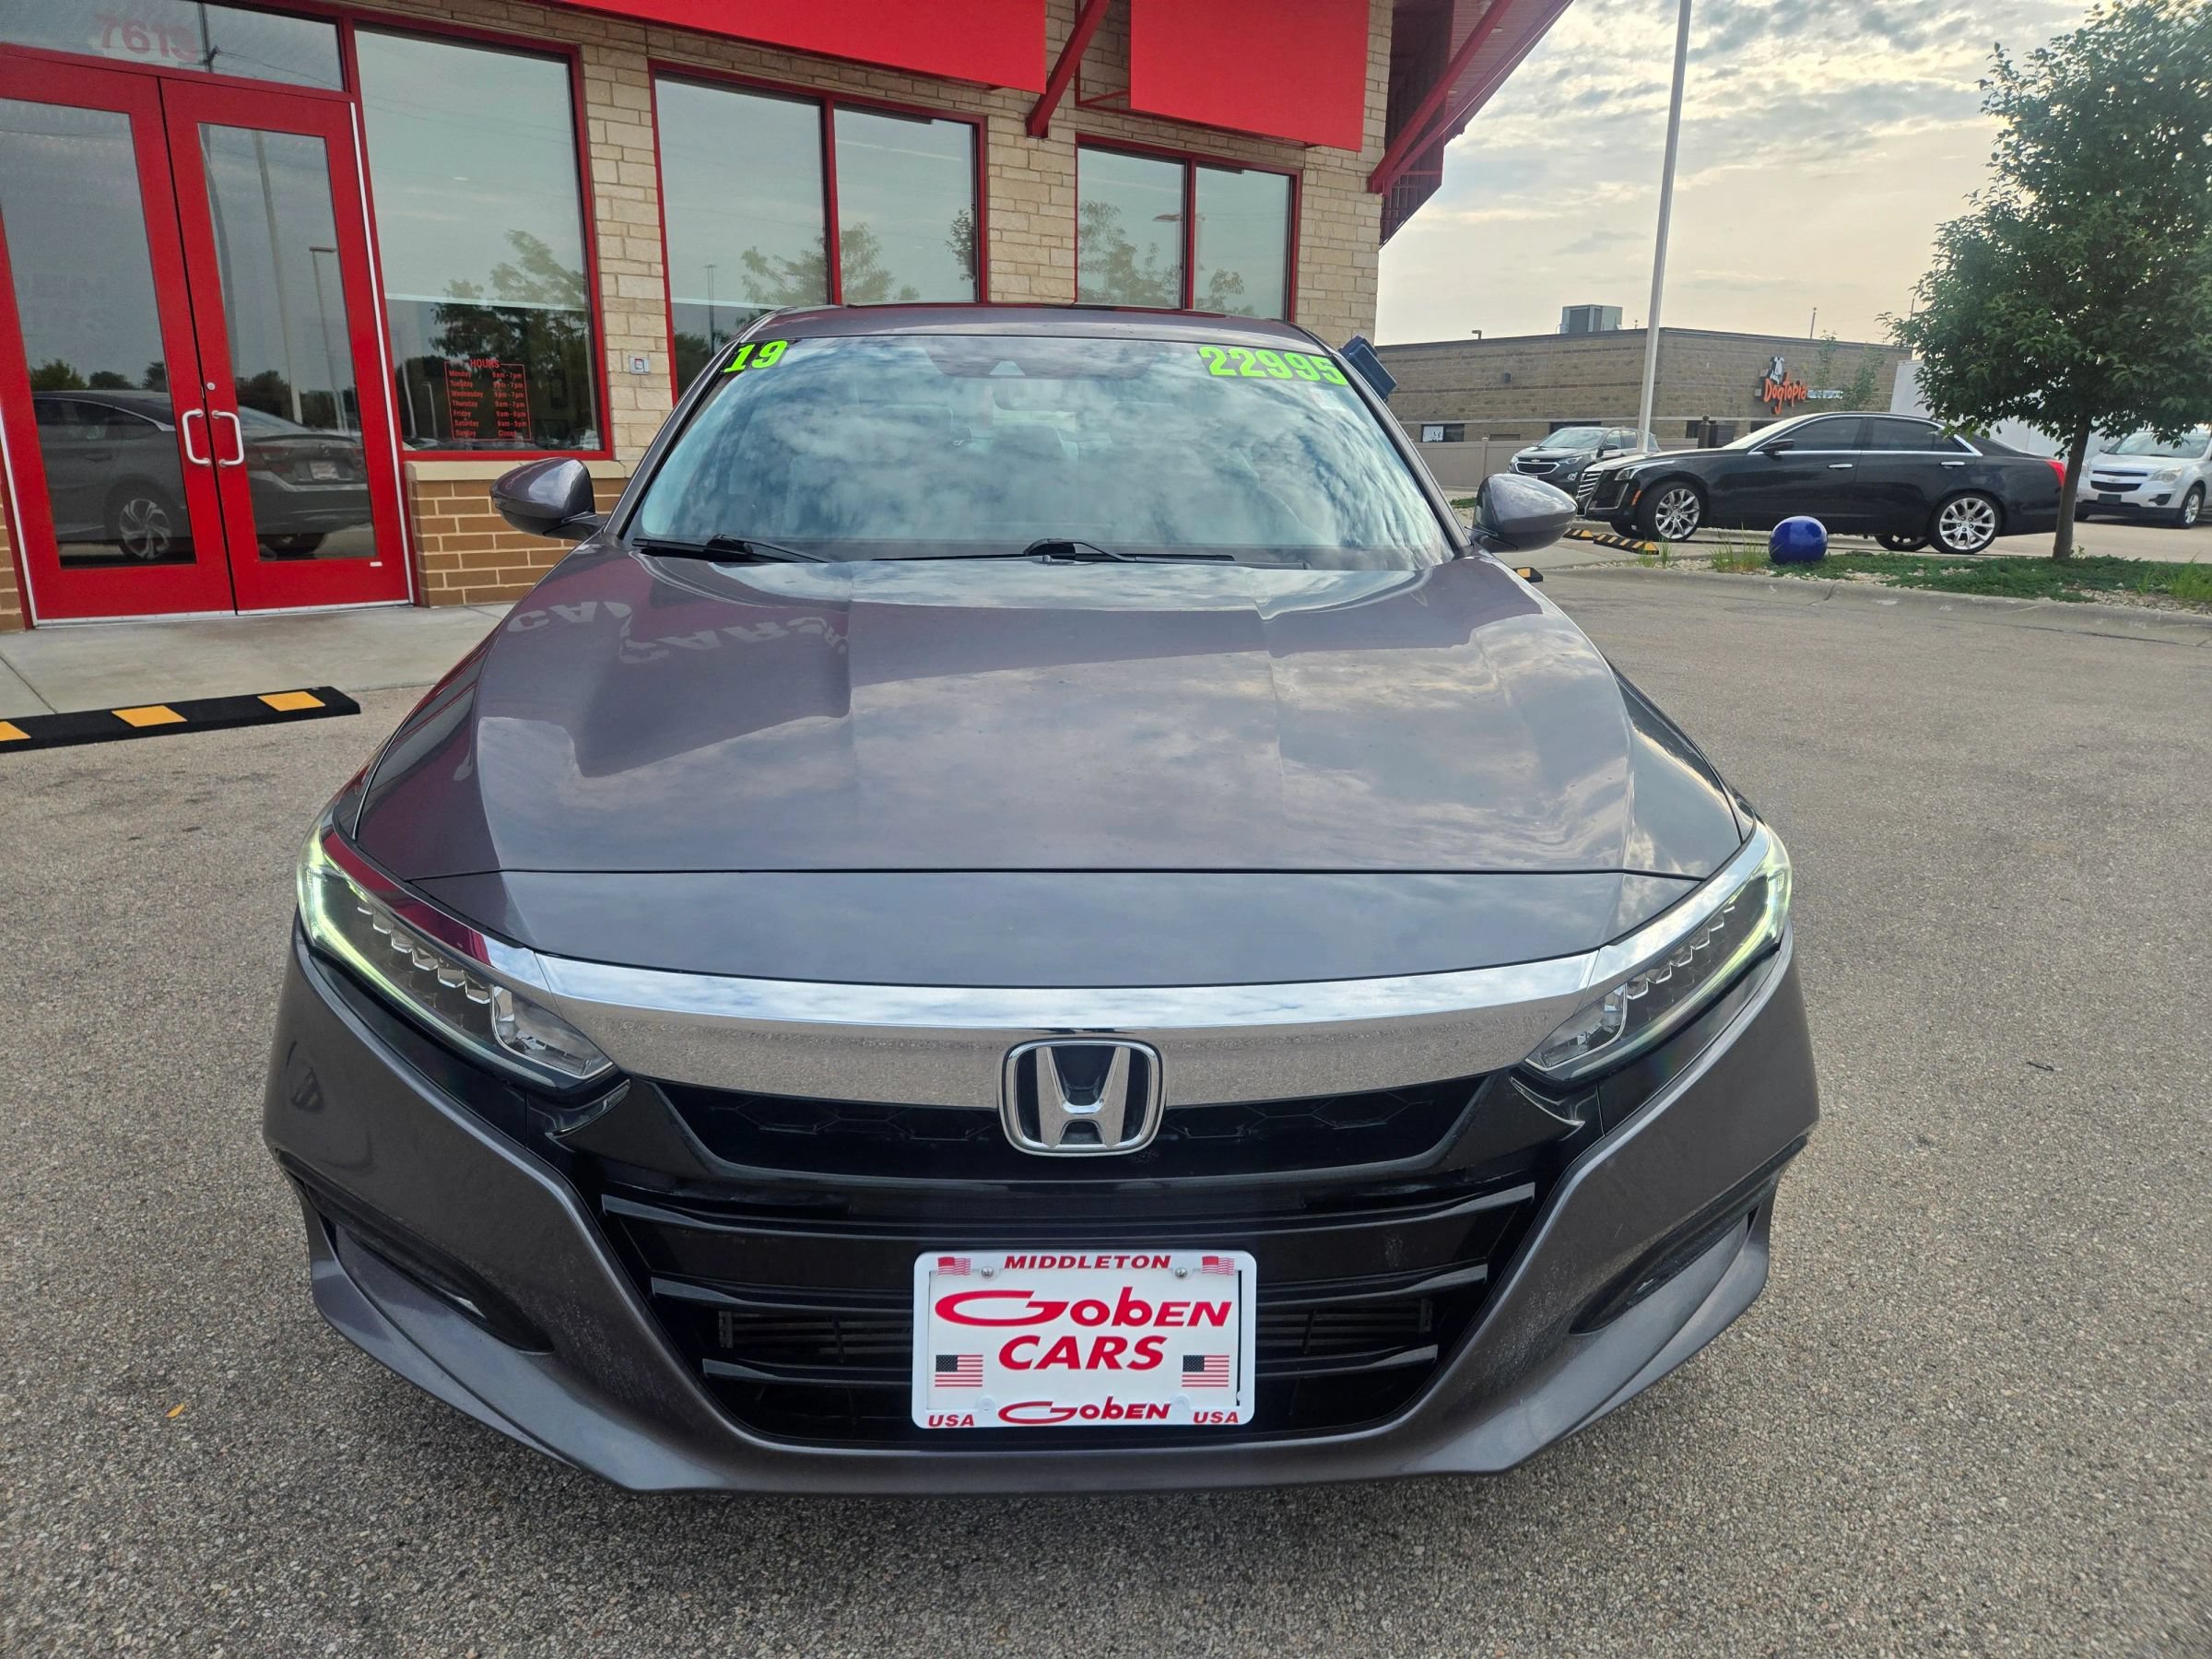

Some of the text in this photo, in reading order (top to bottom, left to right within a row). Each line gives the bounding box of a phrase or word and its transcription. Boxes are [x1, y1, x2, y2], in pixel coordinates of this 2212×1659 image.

[724, 339, 788, 373] 19
[470, 359, 500, 369] HOURS
[1199, 346, 1347, 385] 22995
[449, 371, 472, 379] Monday
[450, 380, 473, 388] Tuesday
[1764, 371, 1806, 414] Dogtopia
[452, 400, 478, 408] Thursday
[453, 409, 472, 418] Friday
[1004, 1254, 1171, 1270] MIDDLETON
[998, 1335, 1169, 1371] CARS
[928, 1414, 975, 1429] USA
[1193, 1411, 1240, 1425] USA
